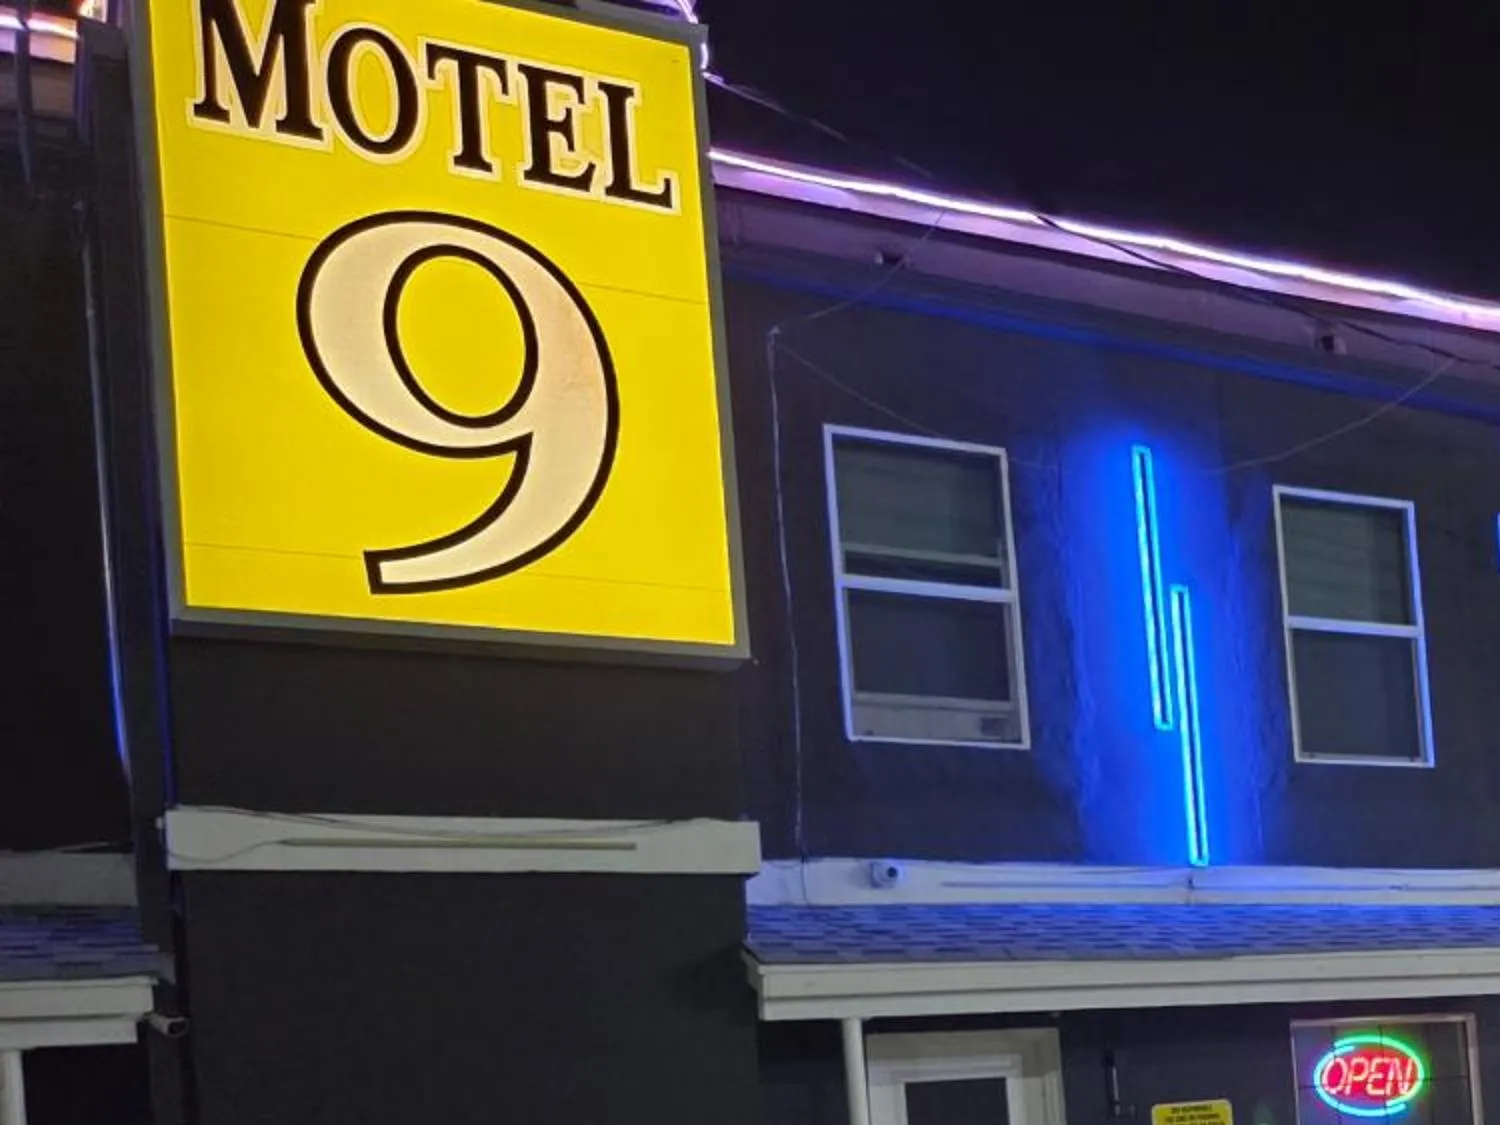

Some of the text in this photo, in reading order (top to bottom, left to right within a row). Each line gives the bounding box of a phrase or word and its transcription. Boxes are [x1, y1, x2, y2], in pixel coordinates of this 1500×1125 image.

[192, 0, 673, 209] MOTEL
[296, 210, 620, 594] 9
[1321, 1057, 1413, 1096] OPEN
